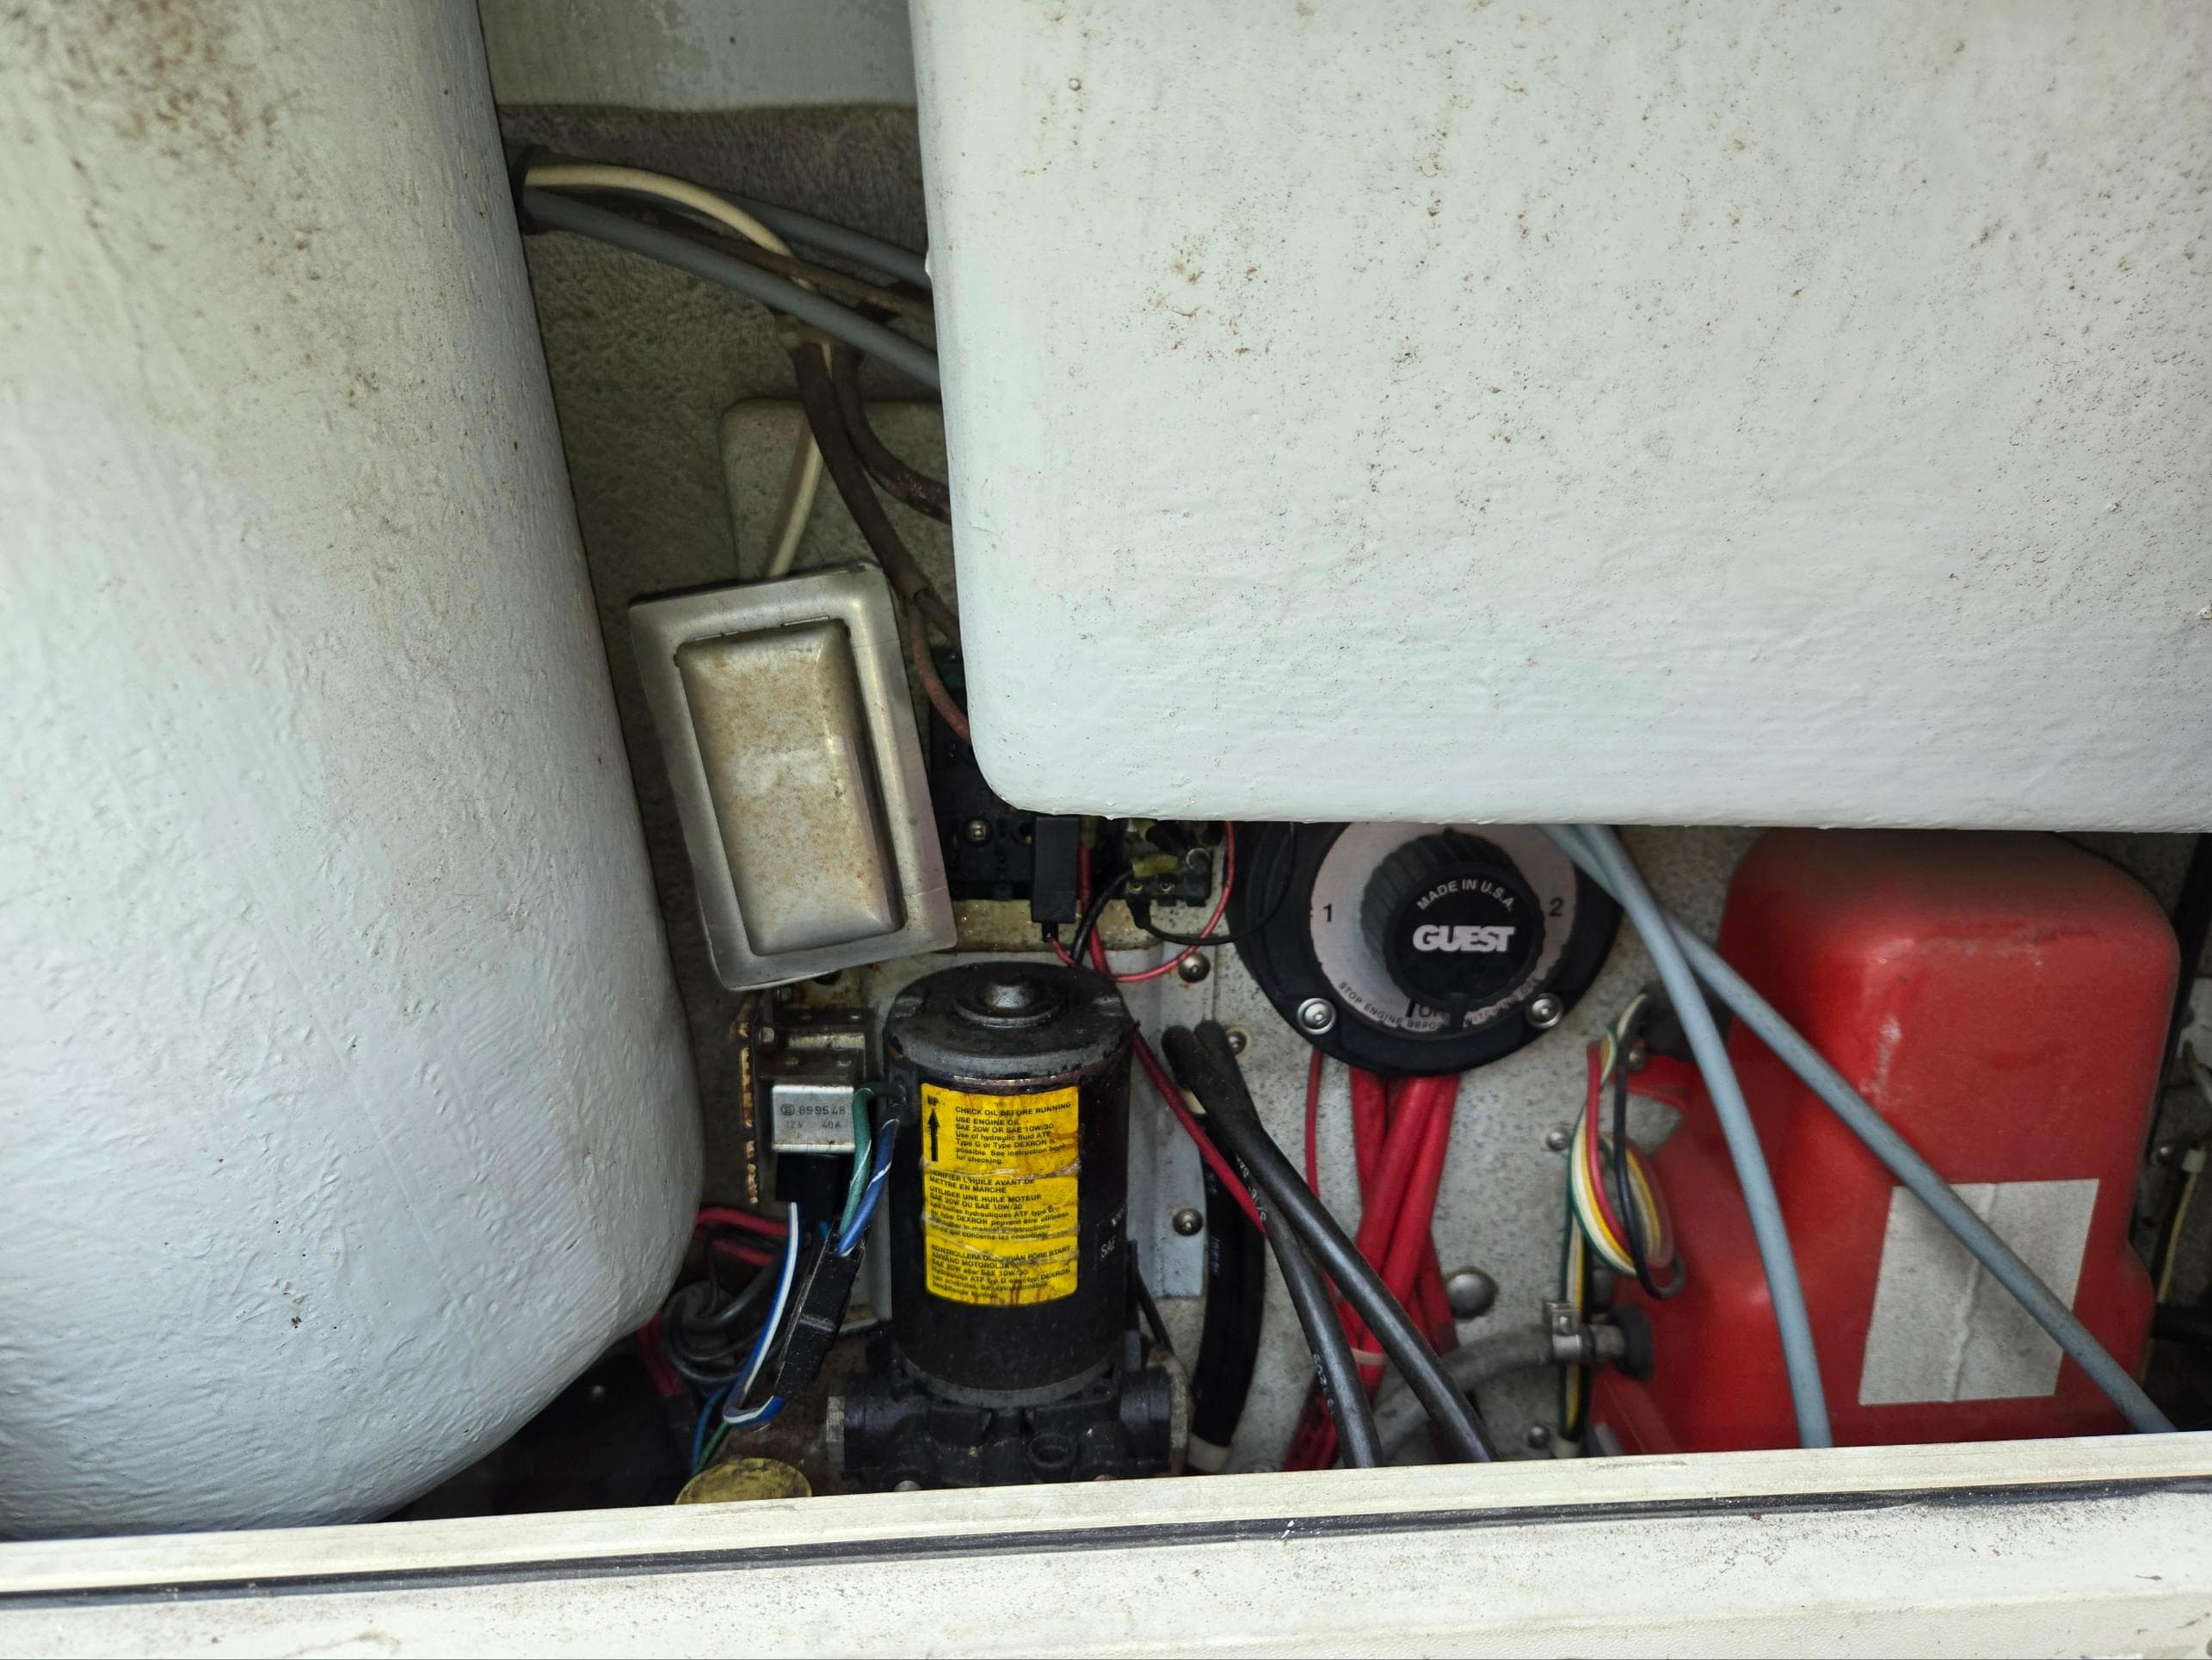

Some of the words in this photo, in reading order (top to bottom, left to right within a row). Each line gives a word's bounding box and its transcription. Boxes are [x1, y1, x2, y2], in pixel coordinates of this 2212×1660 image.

[1416, 879, 1458, 910] MADE
[1462, 879, 1477, 890] IN
[1480, 880, 1514, 912] U.S.A.
[1549, 898, 1563, 916] 2
[1322, 904, 1333, 923] 1
[1412, 924, 1516, 952] GUEST
[1338, 981, 1363, 1003] STOP
[1363, 1003, 1403, 1025] ENGINE
[1406, 1019, 1447, 1030] BEFOR
[927, 1095, 939, 1106] UP
[955, 1106, 983, 1114] CHECK
[1035, 1102, 1071, 1114] RUNNING
[956, 1139, 973, 1147] Type
[1014, 1139, 1047, 1148] DEXRON
[981, 1133, 1015, 1143] hydraulic
[1007, 1147, 1047, 1157] instruction
[930, 1175, 958, 1188] METTRE
[930, 1184, 961, 1198] UTILISER
[1007, 1194, 1042, 1203] MOTEUR
[956, 1214, 989, 1225] DEXRON
[1049, 1245, 1070, 1256] START
[1040, 1268, 1070, 1280] DEXRON
